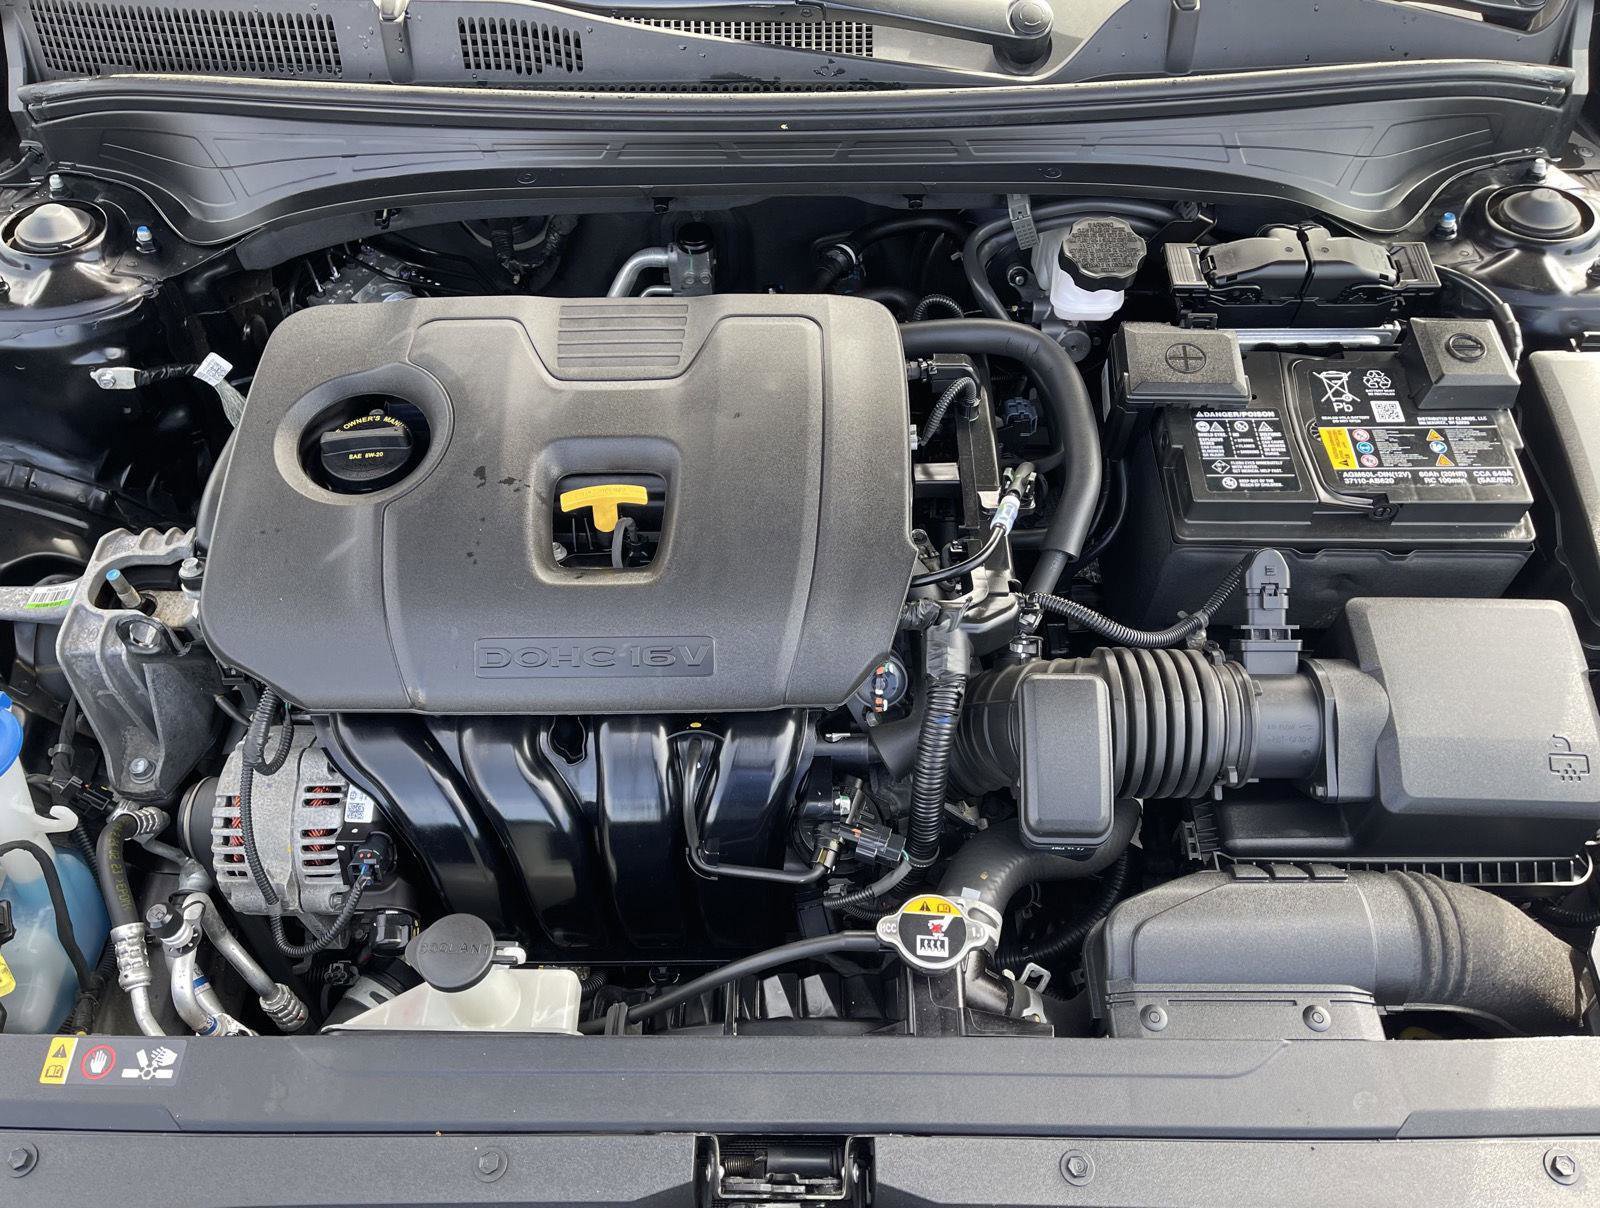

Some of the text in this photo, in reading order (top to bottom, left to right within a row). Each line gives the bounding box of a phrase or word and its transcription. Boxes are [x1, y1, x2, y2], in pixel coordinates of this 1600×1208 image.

[1333, 402, 1353, 412] Pb
[343, 415, 381, 430] OWNER'S
[1441, 470, 1467, 478] (20HR)
[479, 645, 710, 669] DOHC 16V
[880, 923, 897, 933] HCC
[420, 942, 491, 954] COOLANT
